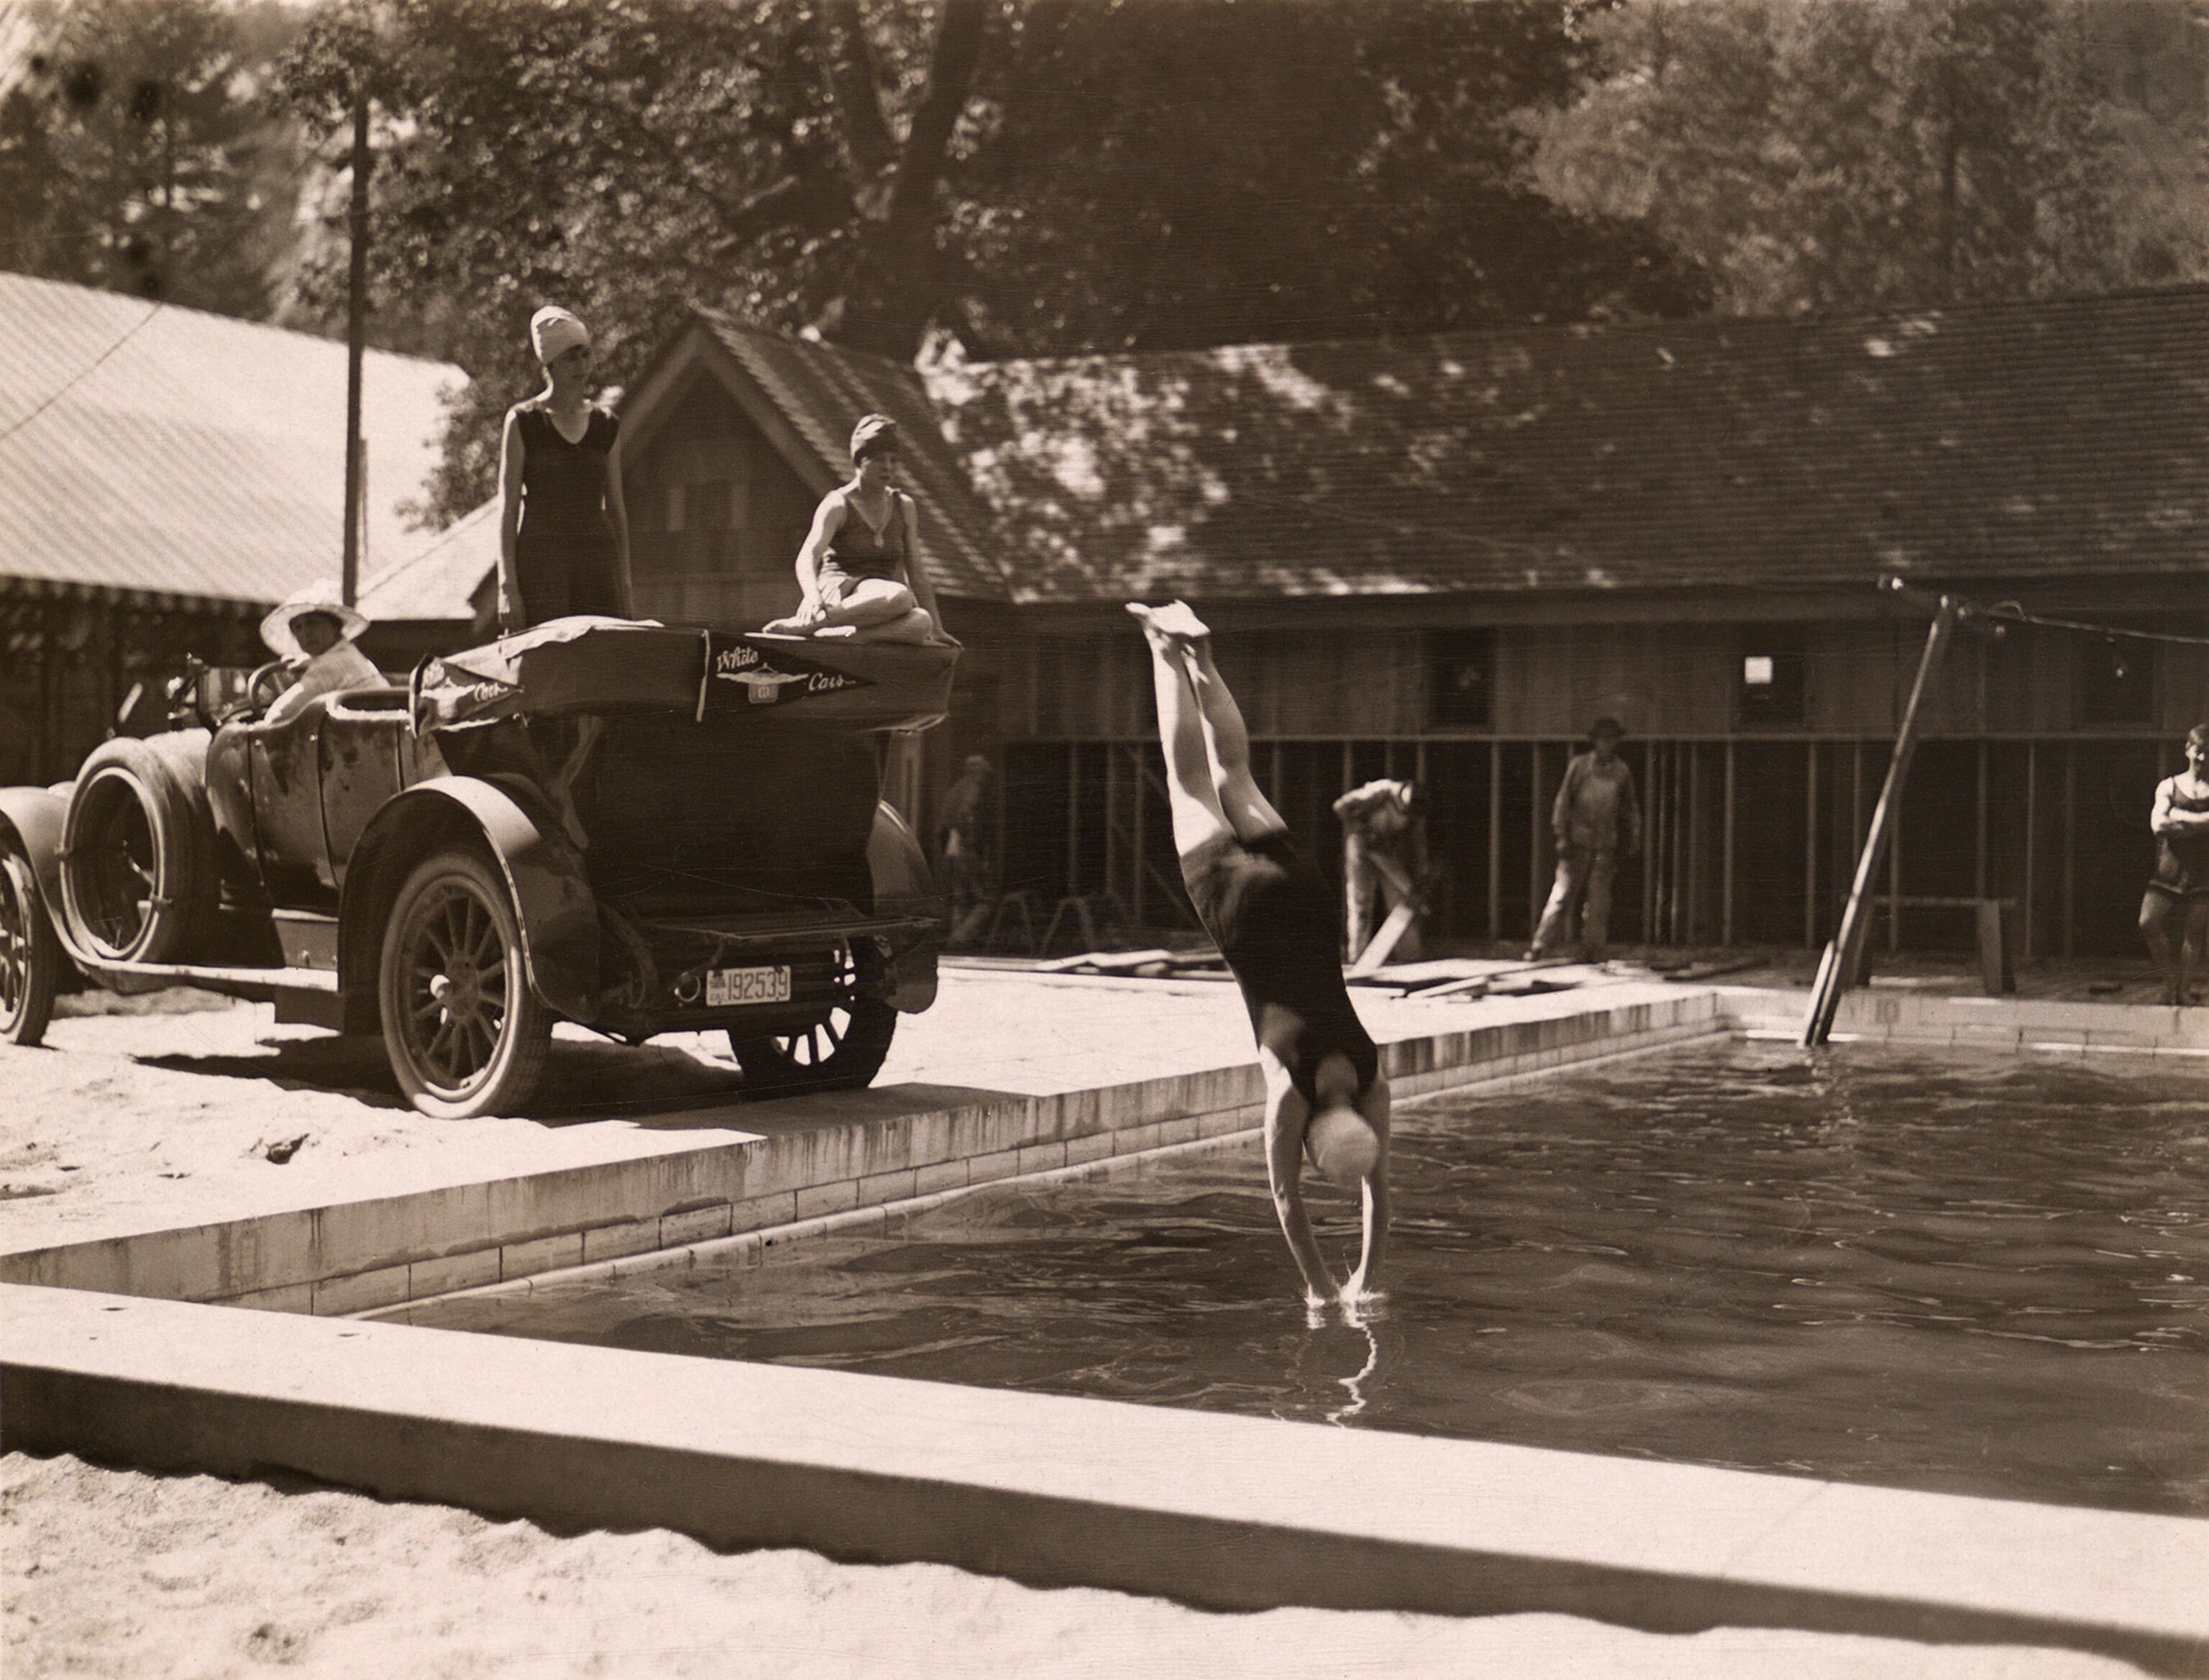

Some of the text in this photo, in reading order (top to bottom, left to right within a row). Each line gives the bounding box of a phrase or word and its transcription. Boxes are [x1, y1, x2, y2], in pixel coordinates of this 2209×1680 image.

[717, 647, 856, 691] White Cars
[728, 971, 788, 1000] 192539
